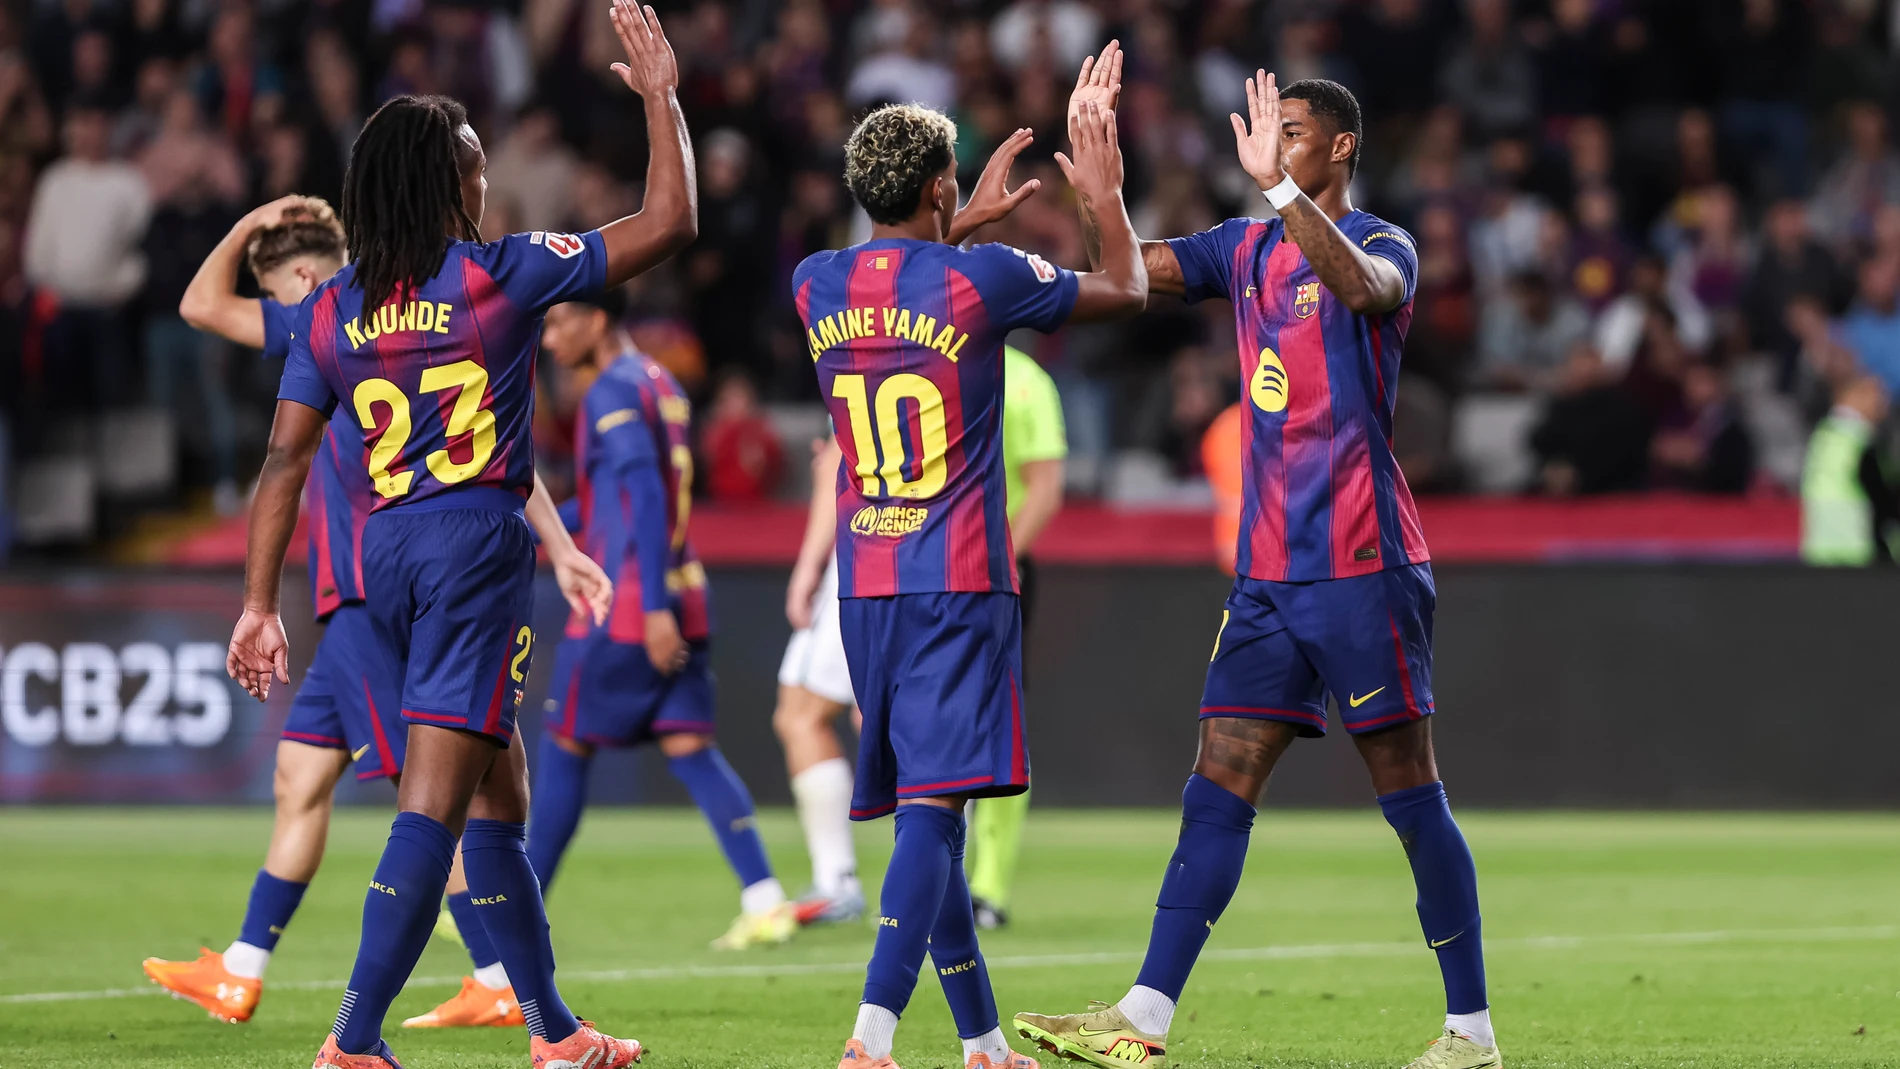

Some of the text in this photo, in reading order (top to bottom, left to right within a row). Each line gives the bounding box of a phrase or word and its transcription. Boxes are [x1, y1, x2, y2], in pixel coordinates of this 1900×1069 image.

[1362, 231, 1412, 248] AMBILIGHT
[343, 300, 453, 351] KOUNDE
[882, 307, 970, 363] YAMAL
[352, 359, 497, 499] 23
[832, 373, 949, 499] 10
[880, 506, 929, 520] UNHCR
[510, 625, 536, 684] 2
[0, 641, 233, 747] CB25
